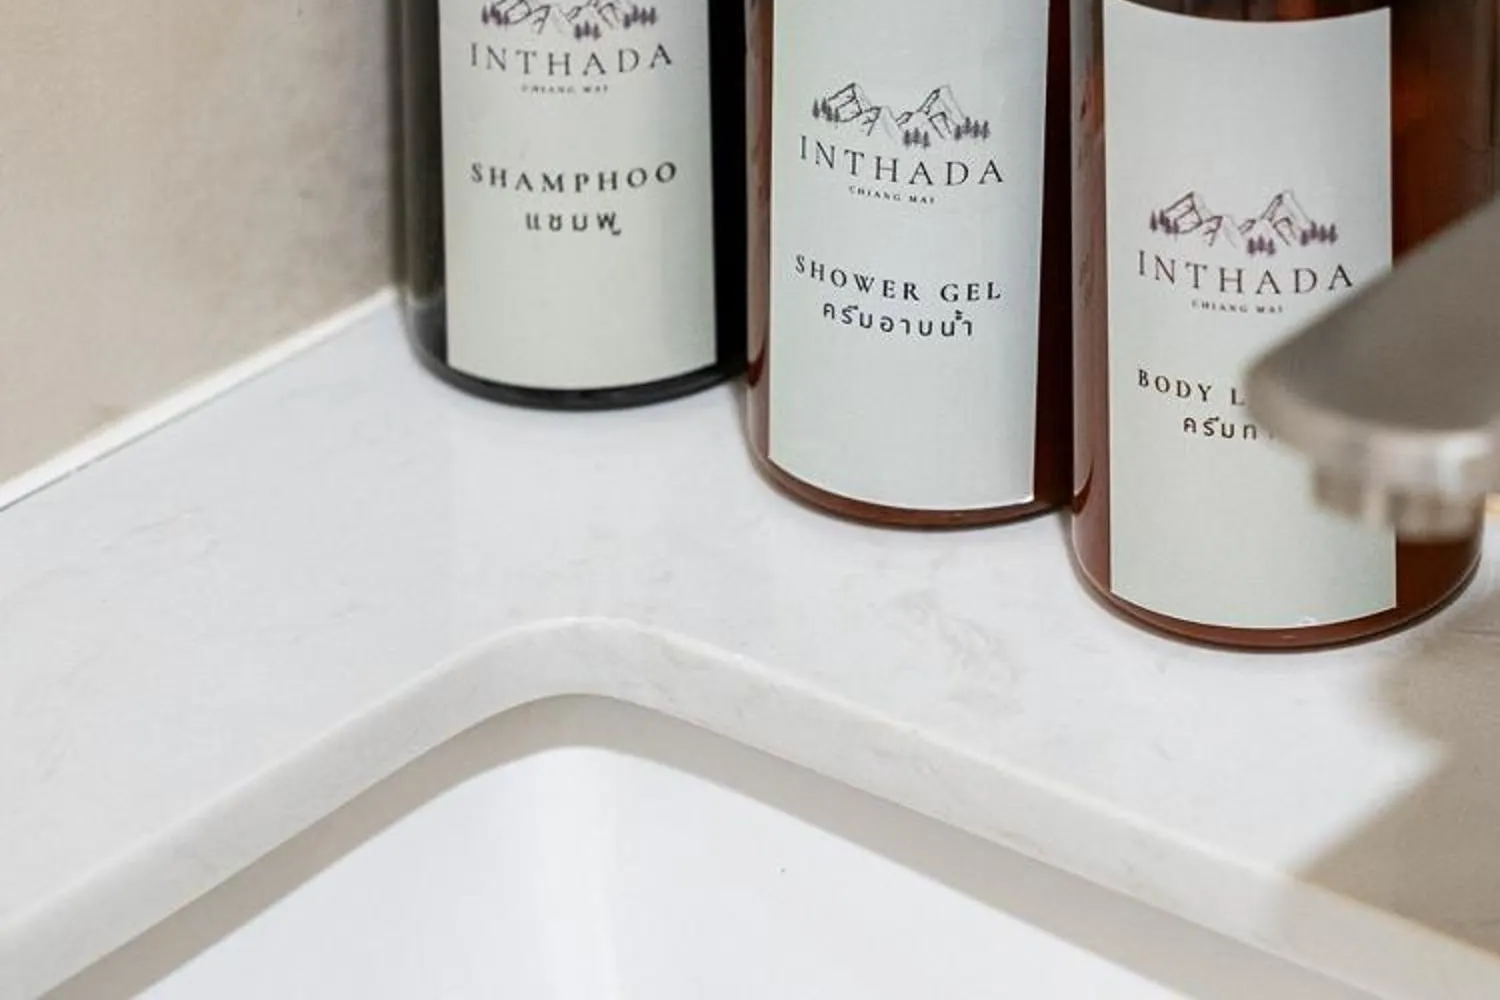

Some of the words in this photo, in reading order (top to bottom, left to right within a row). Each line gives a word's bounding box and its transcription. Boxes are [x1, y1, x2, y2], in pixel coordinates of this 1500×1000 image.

[469, 42, 673, 77] INTHADA
[471, 161, 678, 193] SHAMPHOO
[800, 134, 1004, 187] INTHADA
[848, 185, 902, 201] CHIANG
[795, 254, 921, 301] SHOWER
[939, 281, 1003, 303] GEL
[1138, 250, 1353, 295] INTHADA
[1137, 367, 1213, 403] BODY
